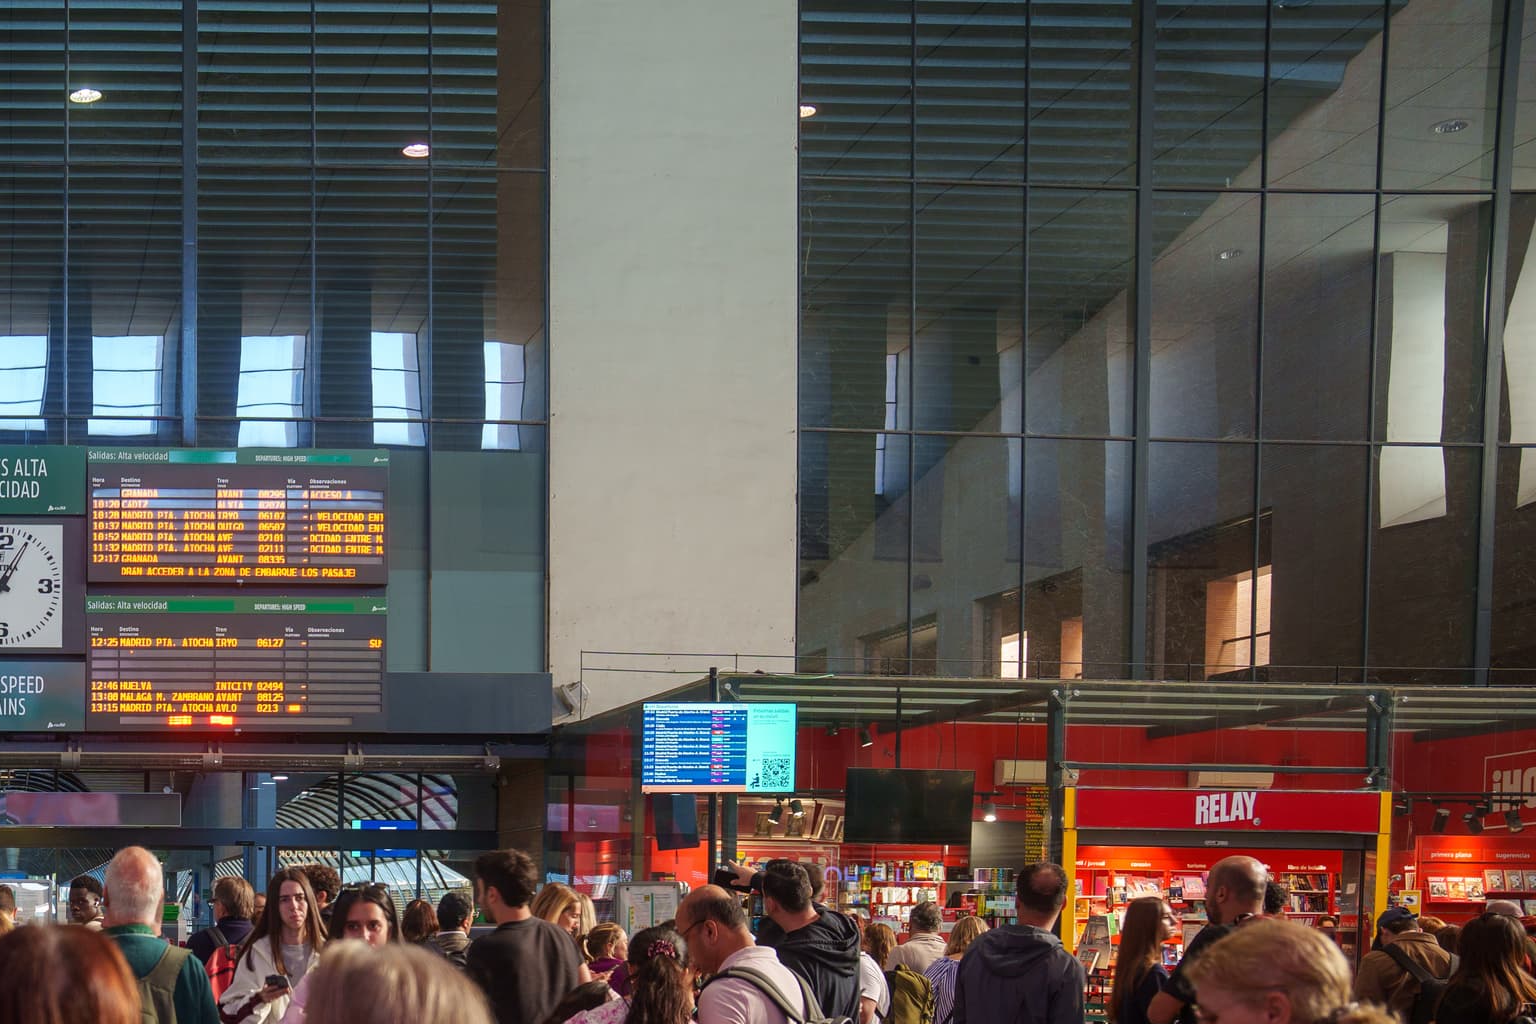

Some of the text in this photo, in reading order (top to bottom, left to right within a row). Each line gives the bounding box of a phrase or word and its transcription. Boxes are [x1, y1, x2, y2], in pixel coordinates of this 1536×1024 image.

[88, 451, 168, 461] Salidas: Alta velocidad
[14, 459, 47, 477] ALTA
[317, 513, 364, 522] VELOCIDAD
[317, 523, 364, 532] VELOCIDAD
[147, 567, 184, 576] ACCEDER
[240, 567, 251, 577] DE
[255, 567, 298, 577] EMBARQUE
[302, 568, 318, 577] LOS
[38, 578, 53, 594] 3
[88, 601, 168, 610] Salidas: Alta velocidad
[120, 638, 152, 647] MADRID
[0, 676, 44, 694] SPEED
[120, 703, 152, 712] MADRID
[1195, 791, 1257, 825] RELAY
